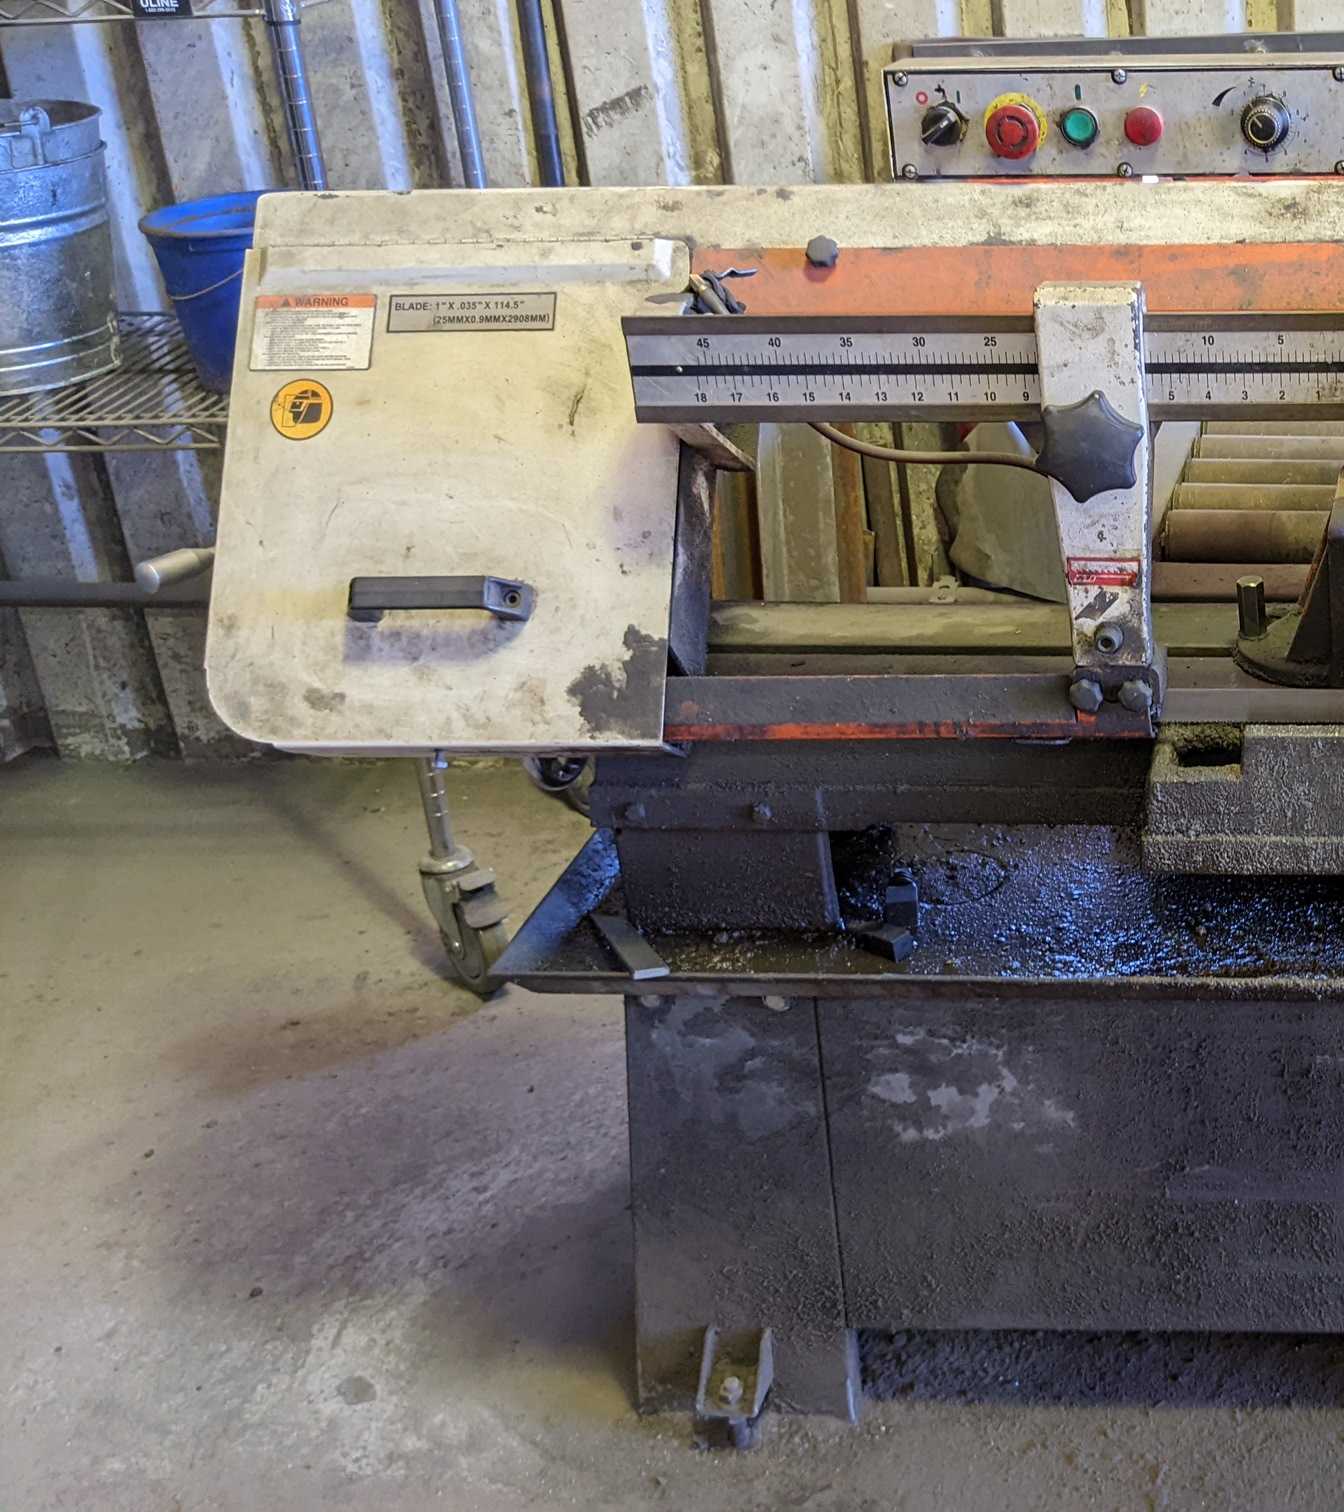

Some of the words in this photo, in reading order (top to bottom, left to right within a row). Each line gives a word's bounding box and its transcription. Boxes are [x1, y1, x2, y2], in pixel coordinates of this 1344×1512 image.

[140, 0, 179, 8] ULINE
[296, 297, 349, 307] WARNING
[395, 301, 433, 312] BLADE:
[448, 301, 456, 311] X
[457, 301, 484, 311] .035"
[485, 301, 493, 311] X
[494, 300, 525, 311] 114.5"
[433, 313, 550, 326] (25MMX0.9MMX2908MM)
[696, 337, 710, 349] 45
[768, 337, 781, 349] 40
[839, 337, 853, 349] 35
[912, 337, 926, 349] 30
[983, 337, 997, 349] 25
[1202, 335, 1215, 347] 10
[1278, 335, 1285, 346] 5
[696, 391, 708, 403] 18
[731, 391, 743, 403] 17
[767, 391, 779, 403] 16
[803, 391, 815, 403] 15
[839, 391, 851, 403] 14
[875, 391, 888, 403] 13
[911, 391, 924, 403] 12
[949, 391, 960, 403] 11
[985, 391, 997, 402] 10
[1023, 391, 1030, 402] 9
[1168, 390, 1175, 401] 5
[1204, 390, 1212, 401] 4
[1241, 390, 1249, 401] 3
[1278, 390, 1286, 401] 2
